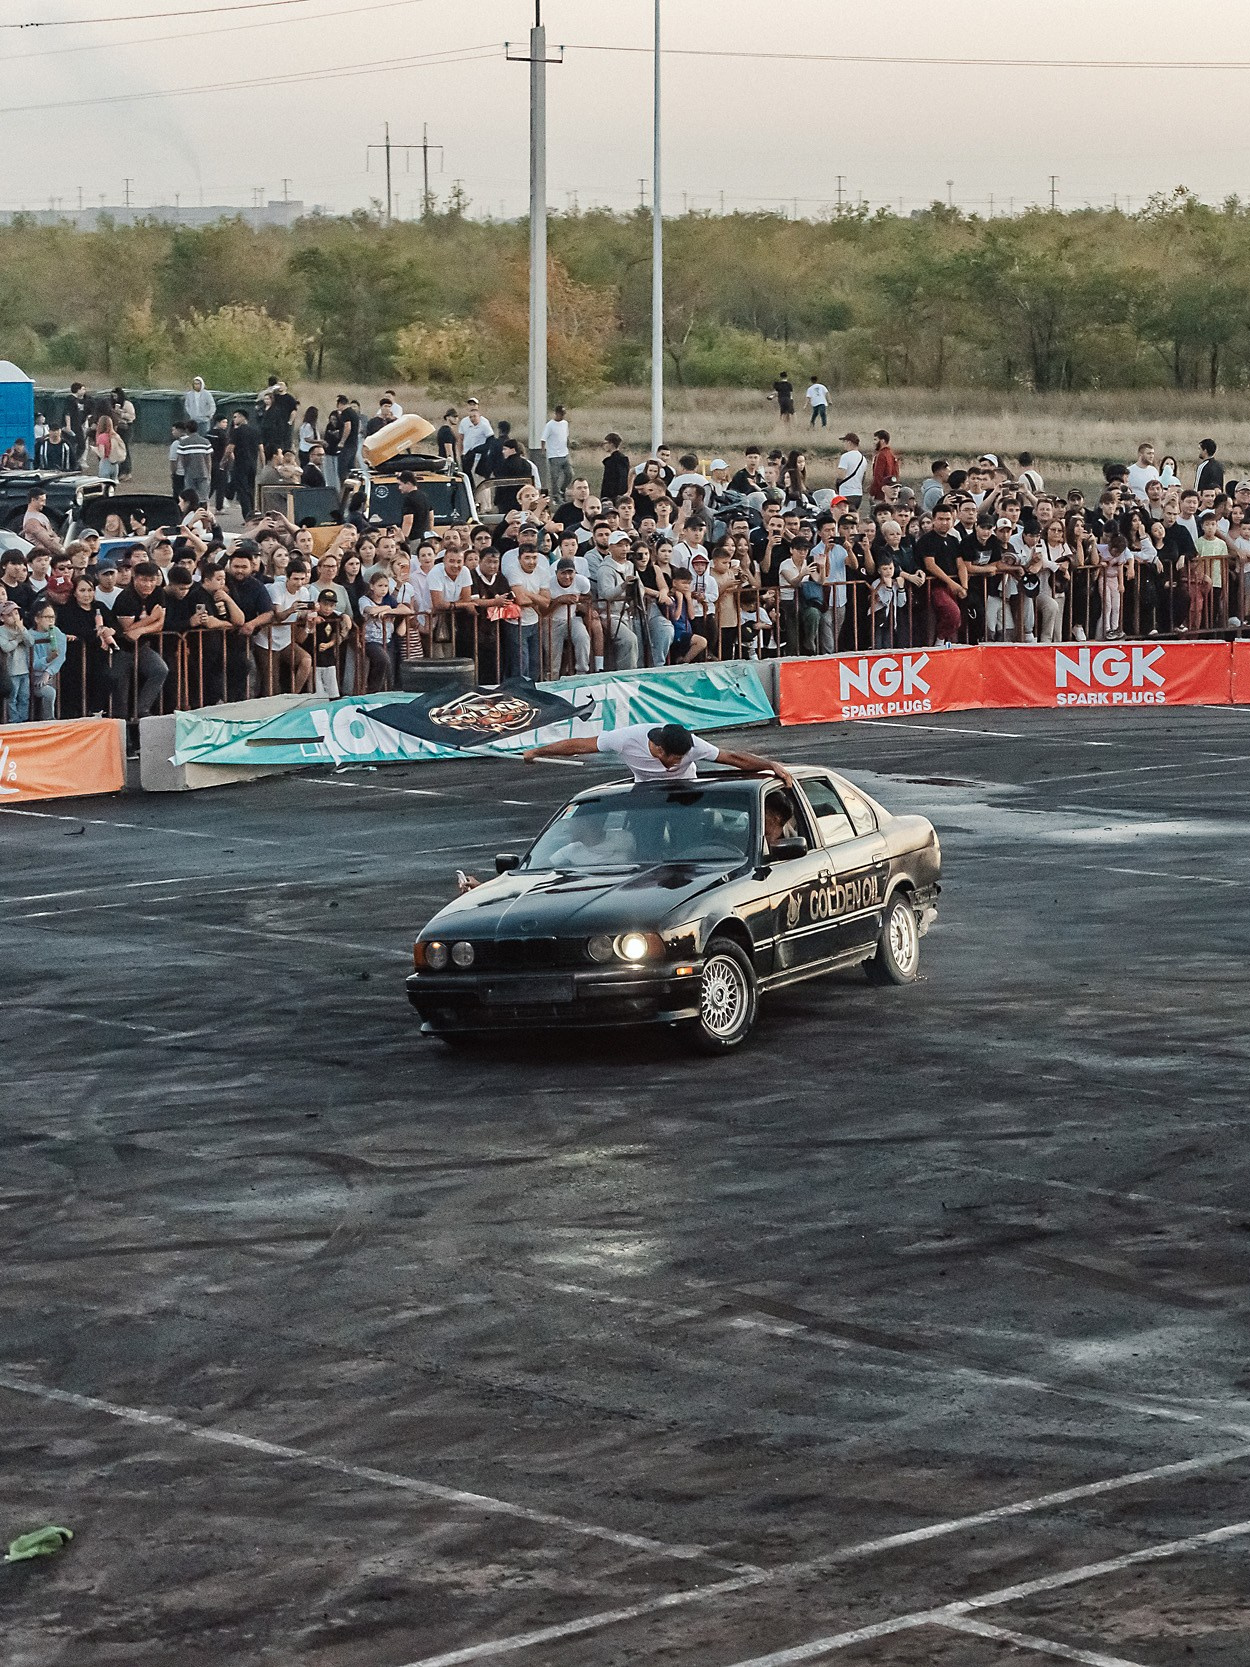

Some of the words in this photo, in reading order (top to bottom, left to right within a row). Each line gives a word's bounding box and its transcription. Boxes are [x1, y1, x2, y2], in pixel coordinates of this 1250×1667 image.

[839, 652, 931, 701] NGK
[1055, 646, 1166, 688] NGK
[841, 702, 885, 719] SPARK
[887, 698, 932, 714] PLUGS
[1056, 693, 1109, 706] SPARK
[1112, 691, 1166, 704] PLUGS
[809, 879, 861, 921] GOLDEN
[863, 874, 882, 905] OIL
